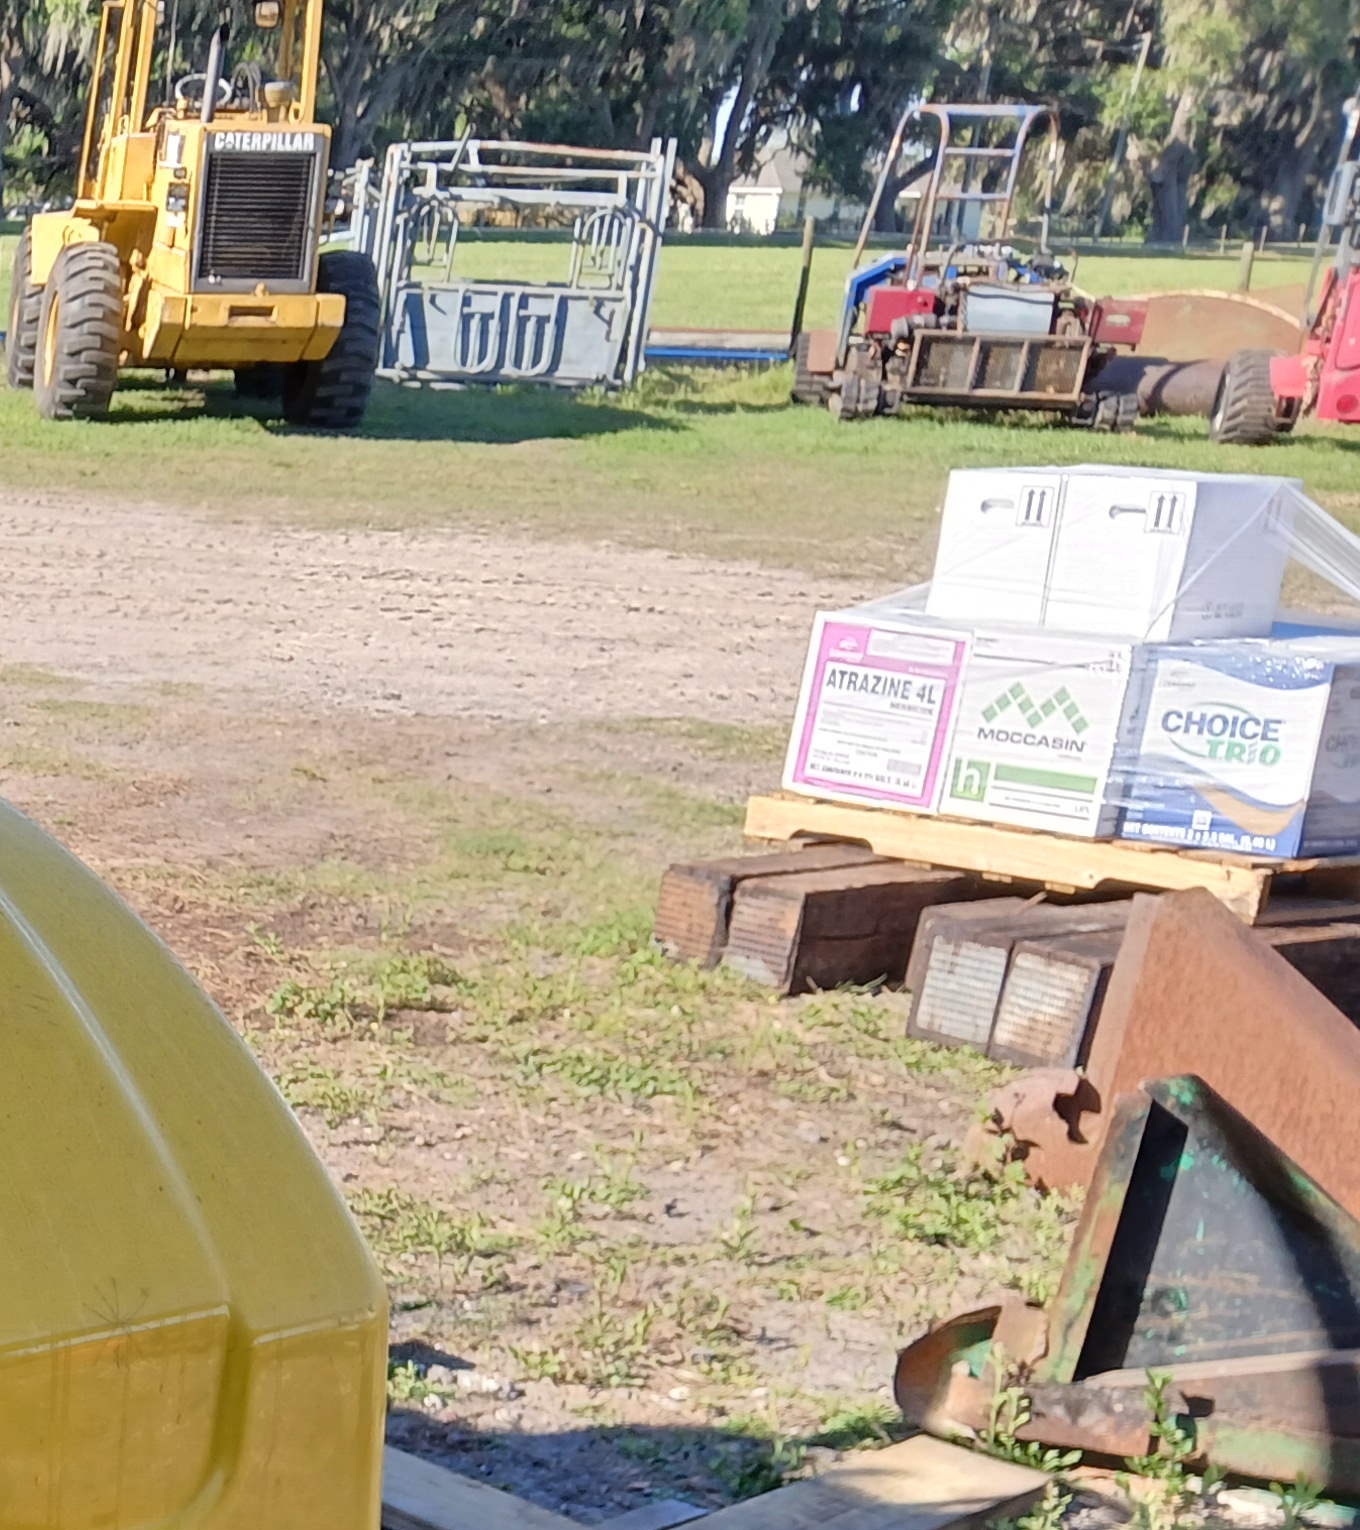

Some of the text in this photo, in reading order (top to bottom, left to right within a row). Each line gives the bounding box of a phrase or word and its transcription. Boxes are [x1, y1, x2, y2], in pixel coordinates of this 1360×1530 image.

[215, 132, 314, 151] CATERPILLAR
[826, 667, 912, 700] ATRAZINE
[916, 683, 936, 705] 4L
[977, 727, 1086, 752] MOCCASIN
[1161, 709, 1283, 742] CHOICE
